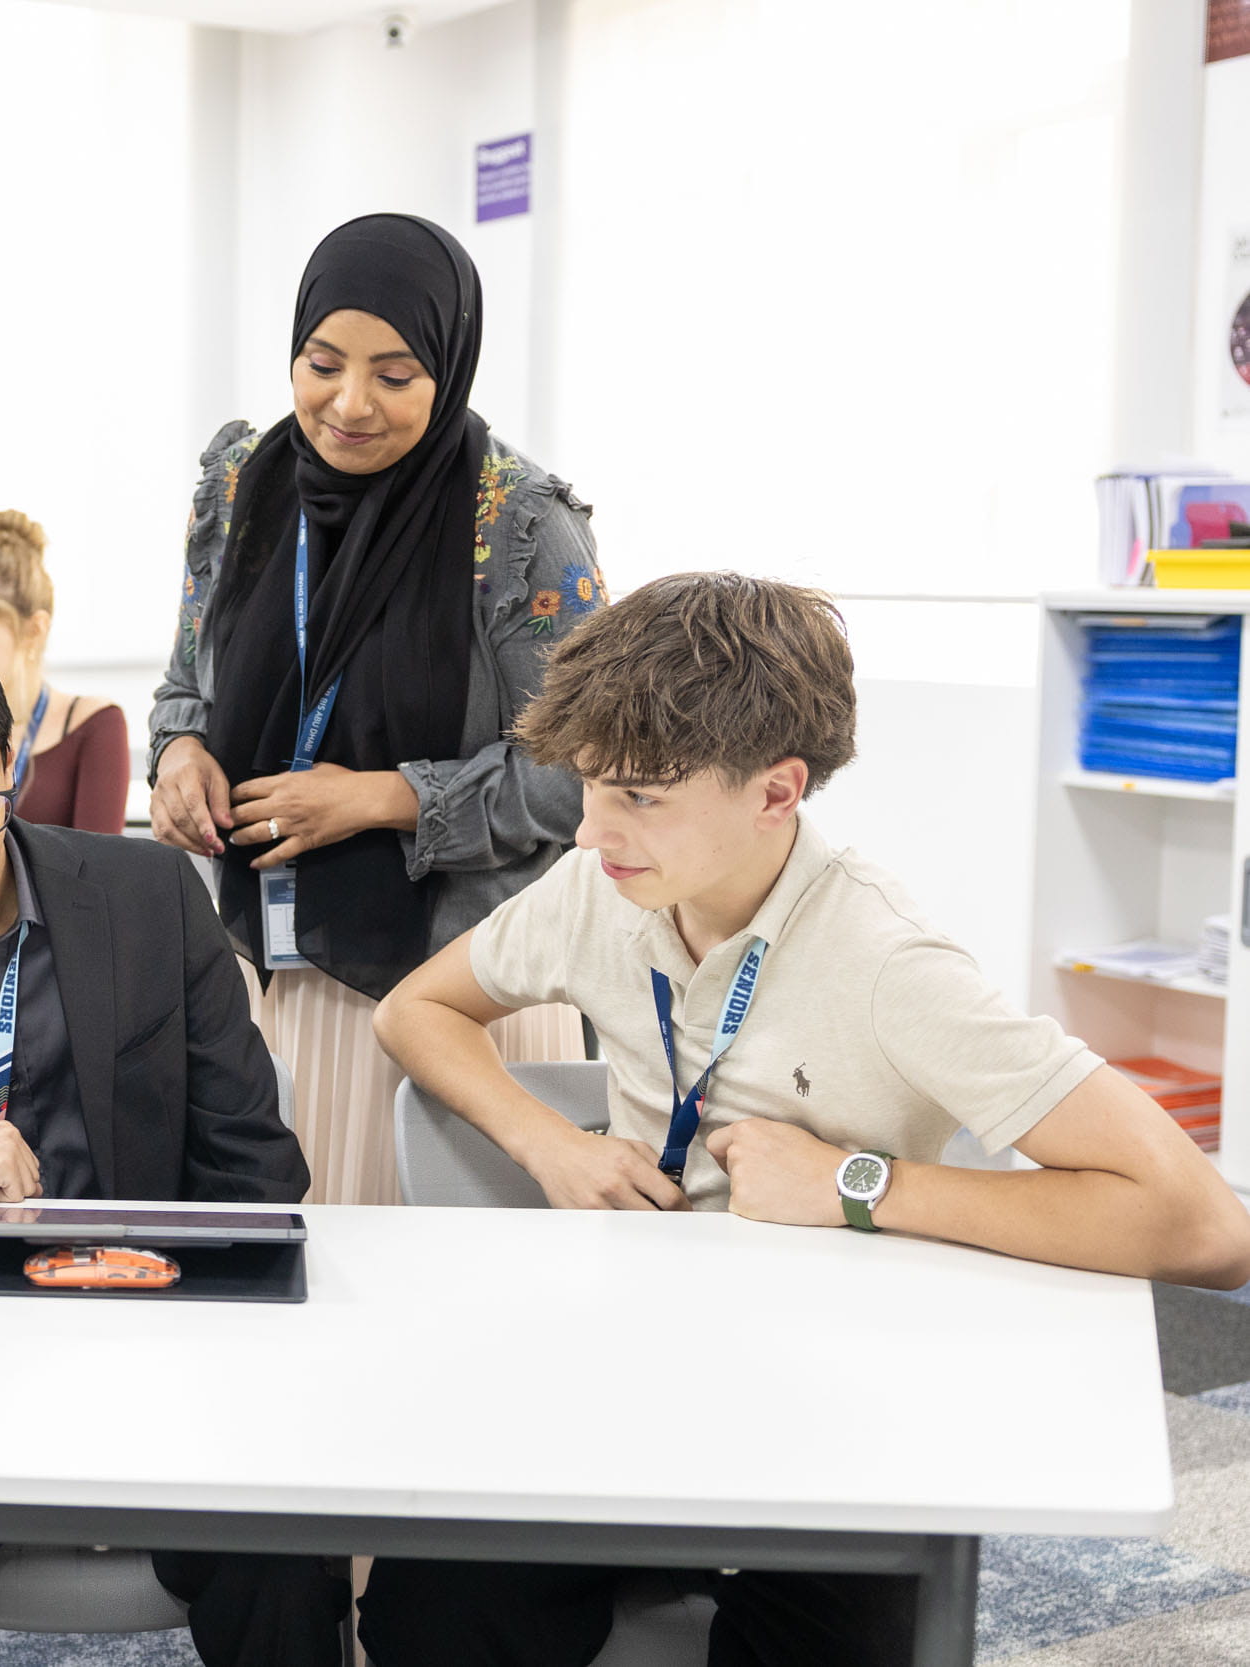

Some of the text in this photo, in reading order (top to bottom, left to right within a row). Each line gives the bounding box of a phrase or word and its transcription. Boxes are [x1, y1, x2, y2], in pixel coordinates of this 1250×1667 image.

[304, 697, 328, 752] BIS ABU DHABI
[721, 950, 761, 1035] SENIORS
